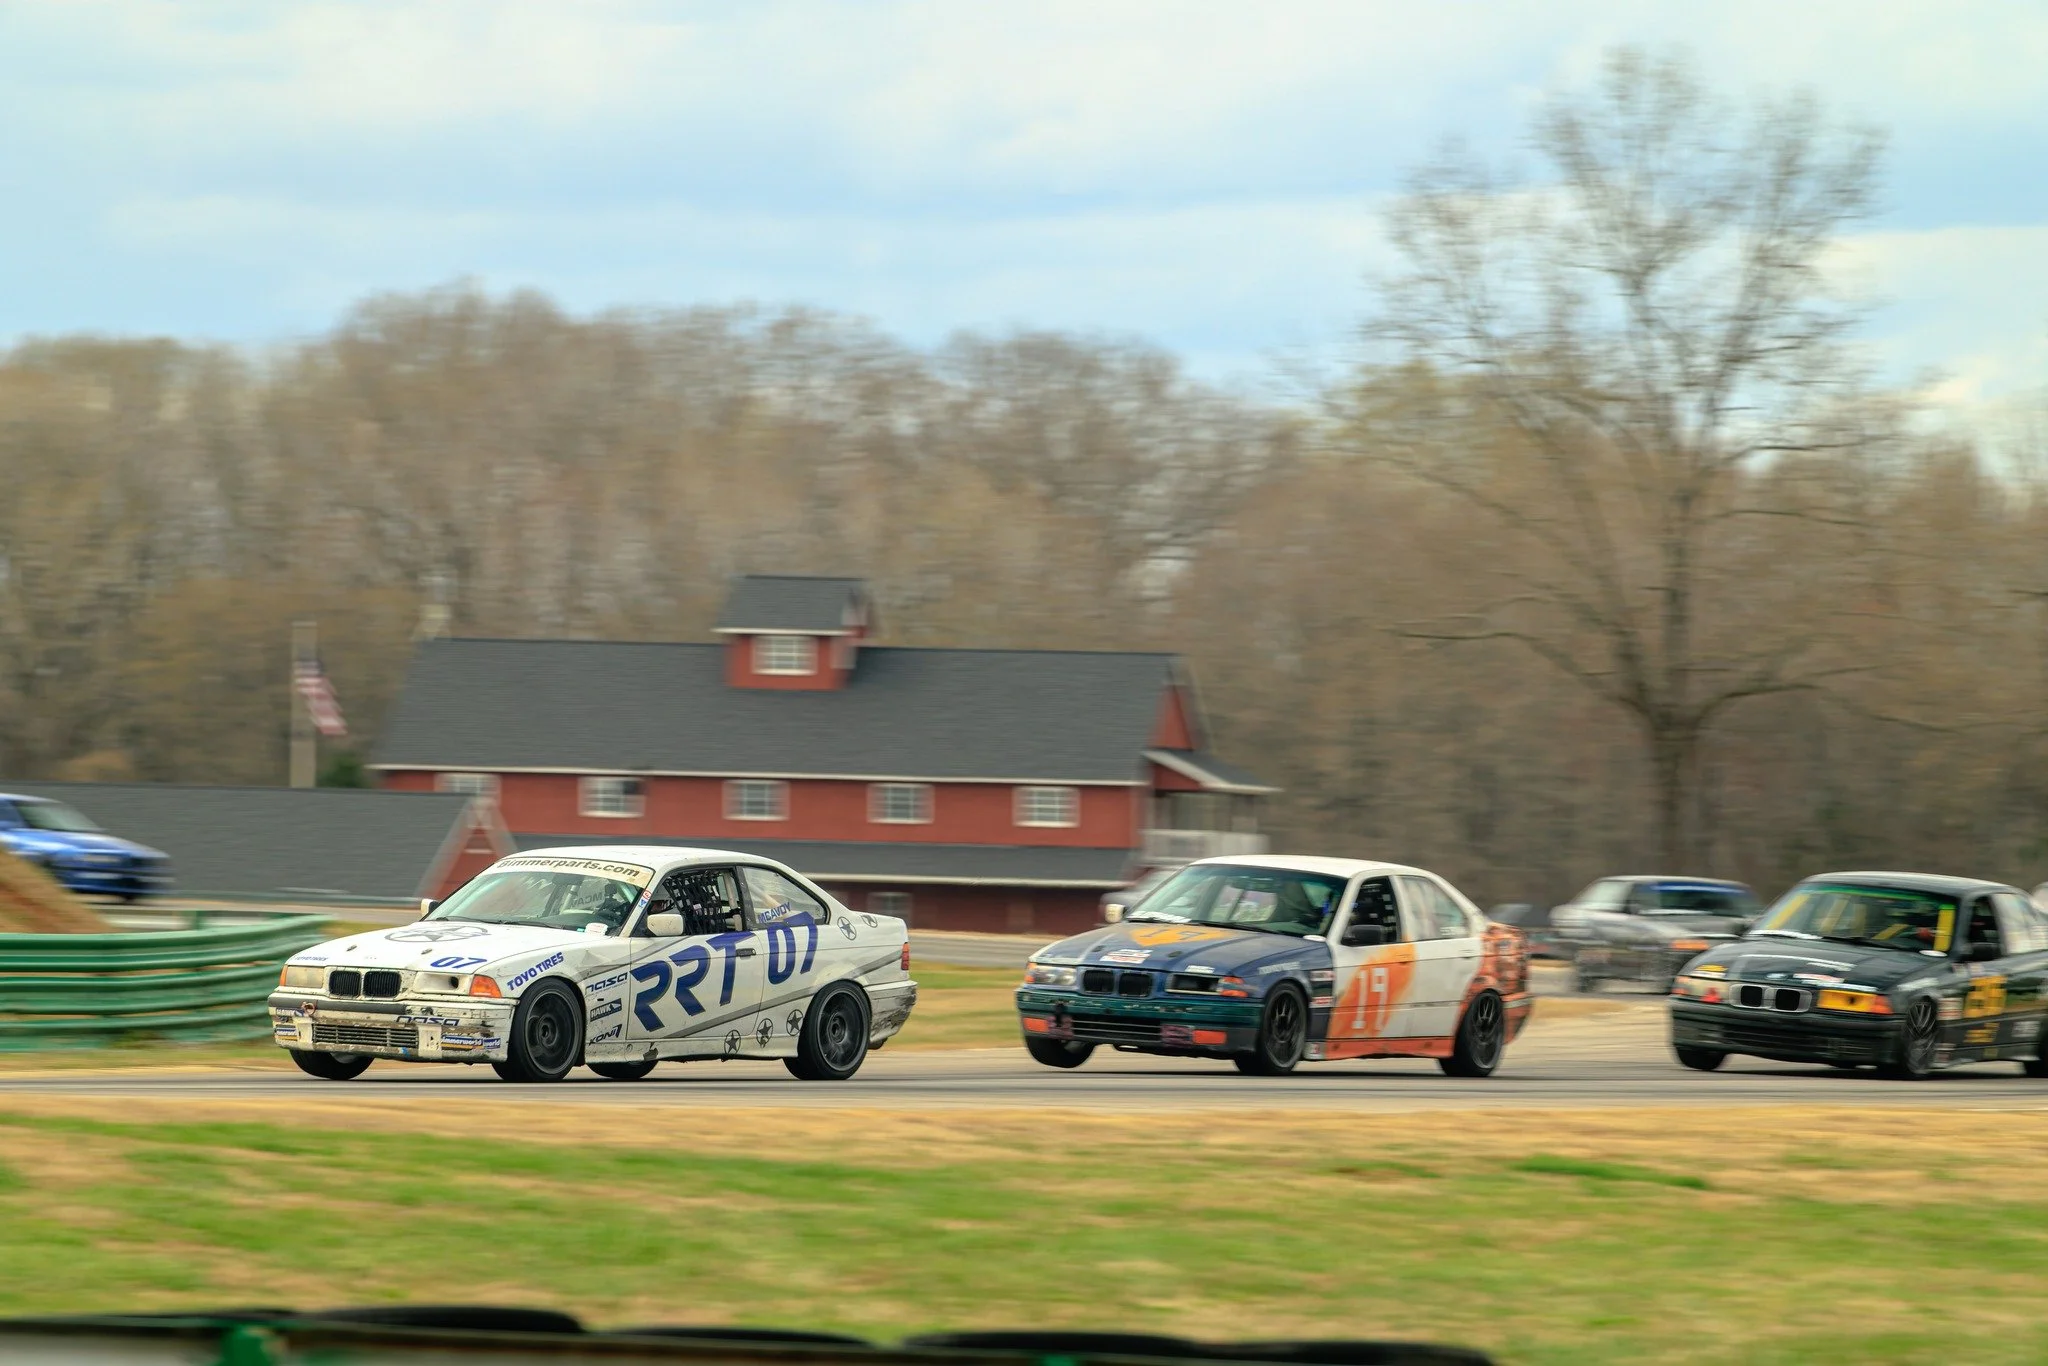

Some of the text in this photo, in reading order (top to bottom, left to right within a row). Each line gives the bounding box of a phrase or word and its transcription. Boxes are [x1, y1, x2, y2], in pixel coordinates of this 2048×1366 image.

[497, 858, 640, 878] Bimmerparts.com
[757, 901, 792, 924] MCAVOY
[430, 956, 488, 969] 07
[767, 911, 819, 985] 07
[506, 951, 565, 992] TOYO TIRES
[629, 931, 757, 1033] RRT
[590, 1003, 612, 1018] HAWK
[1350, 967, 1390, 1031] 19
